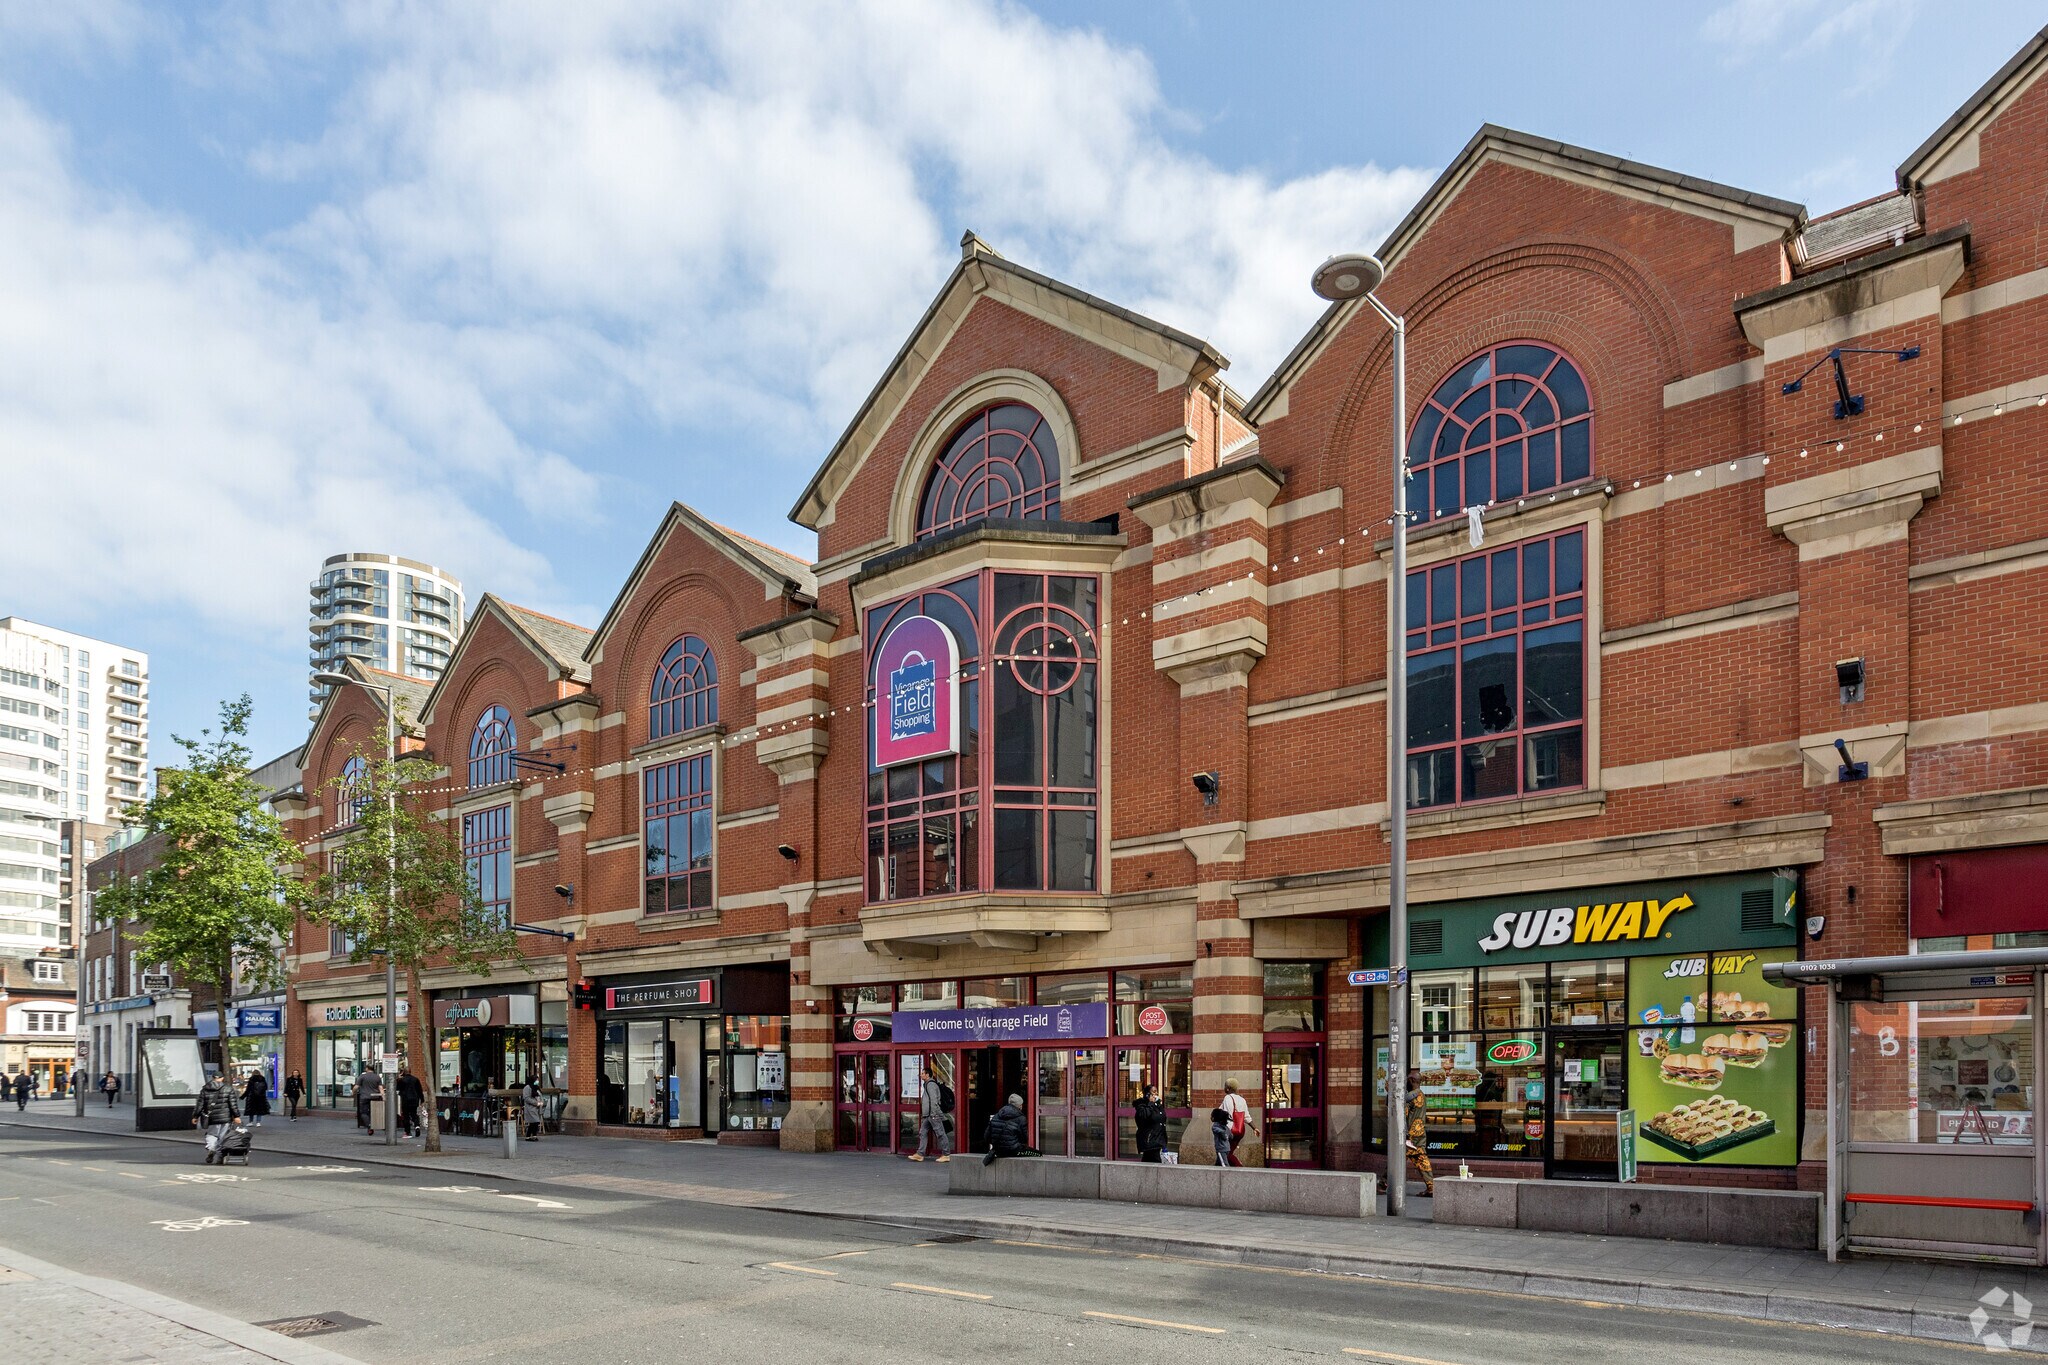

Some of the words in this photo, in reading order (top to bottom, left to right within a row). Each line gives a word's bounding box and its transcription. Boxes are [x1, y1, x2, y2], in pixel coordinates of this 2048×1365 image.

[895, 678, 930, 694] Vicarage
[895, 688, 930, 716] Field
[894, 712, 930, 729] Shopping
[1477, 893, 1695, 954] SUBWAY
[1662, 952, 1757, 980] SUBWAY
[616, 993, 630, 1003] THE
[634, 990, 670, 1001] PERFUME
[674, 988, 697, 999] SHOP
[326, 1006, 351, 1021] Holland
[356, 1005, 383, 1019] Barrett
[919, 1018, 963, 1031] Welcome
[965, 1017, 975, 1029] to
[977, 1015, 1021, 1031] Vicarage
[1023, 1013, 1049, 1027] Field
[1142, 1018, 1163, 1026] OFFICE
[1494, 1045, 1531, 1058] OPEN
[1988, 1121, 1999, 1129] ID
[1427, 1142, 1459, 1150] SUBWAY
[1492, 1143, 1527, 1151] SUBWAY
